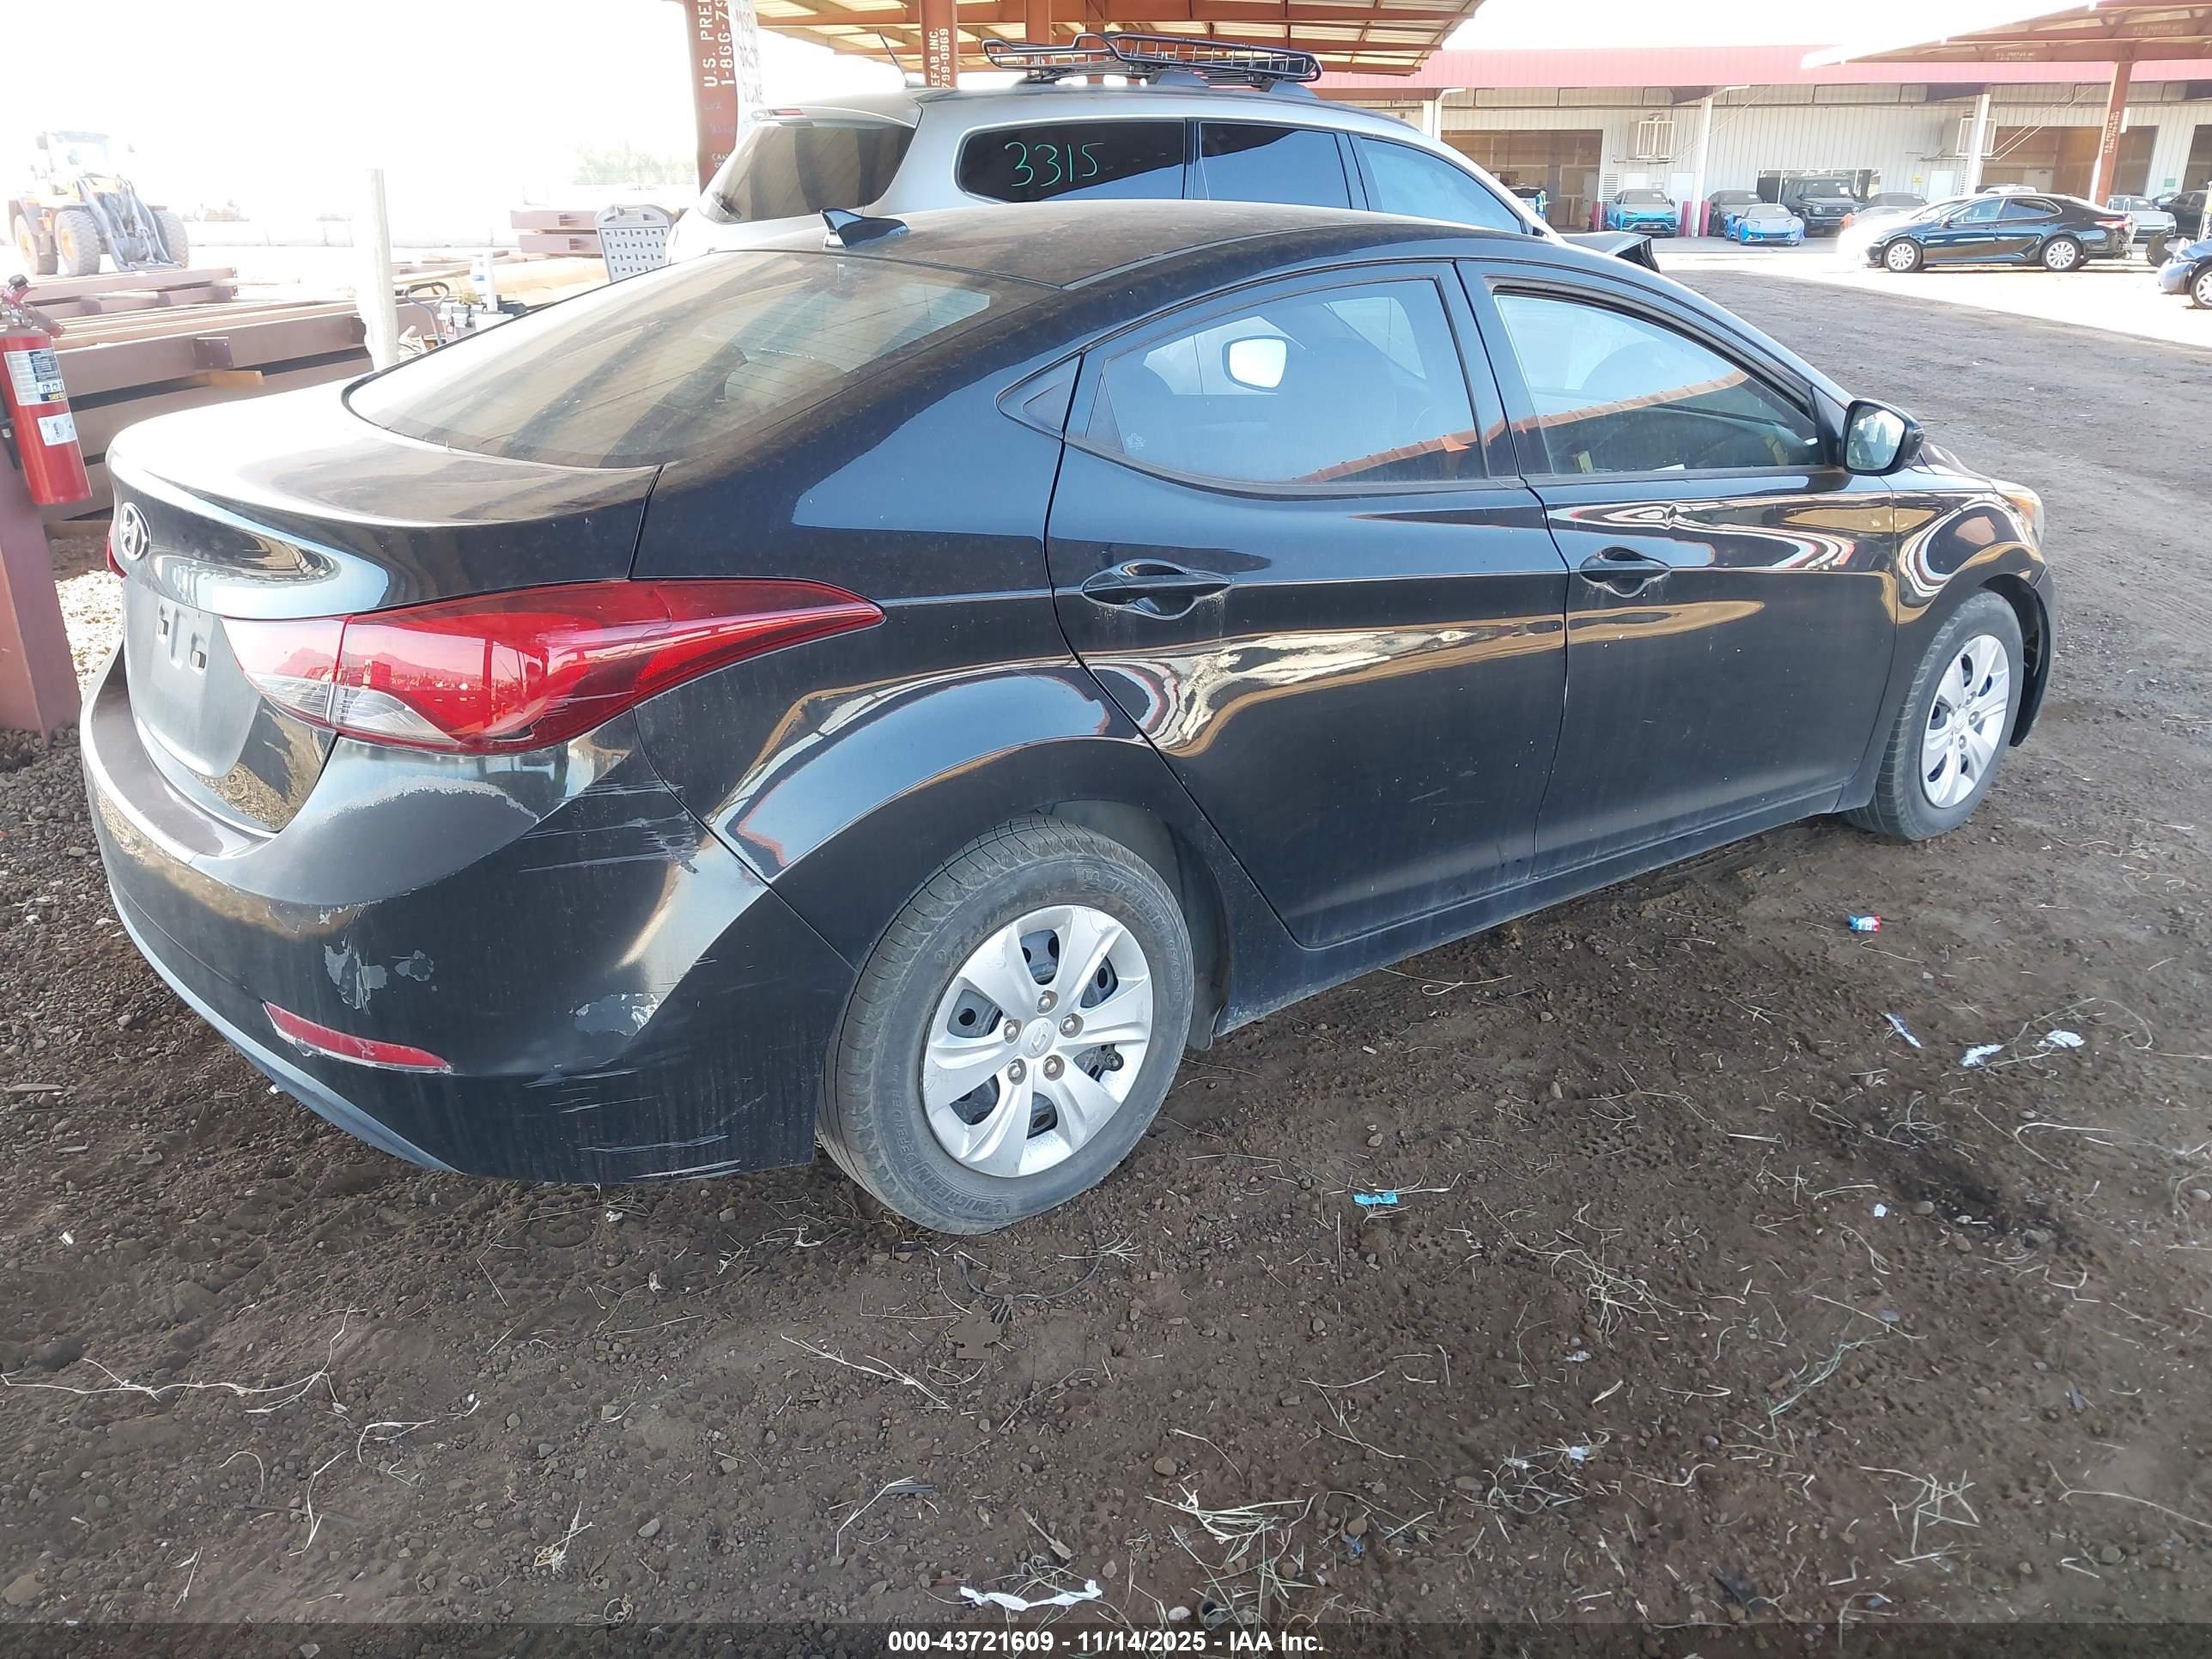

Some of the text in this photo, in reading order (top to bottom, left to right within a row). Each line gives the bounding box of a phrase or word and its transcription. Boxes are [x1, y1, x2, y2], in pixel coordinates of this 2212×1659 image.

[697, 0, 714, 40] PRE
[928, 27, 939, 50] INC.
[702, 52, 718, 87] U.S.
[1004, 142, 1105, 187] 3315
[910, 1164, 989, 1212] MICHELIN
